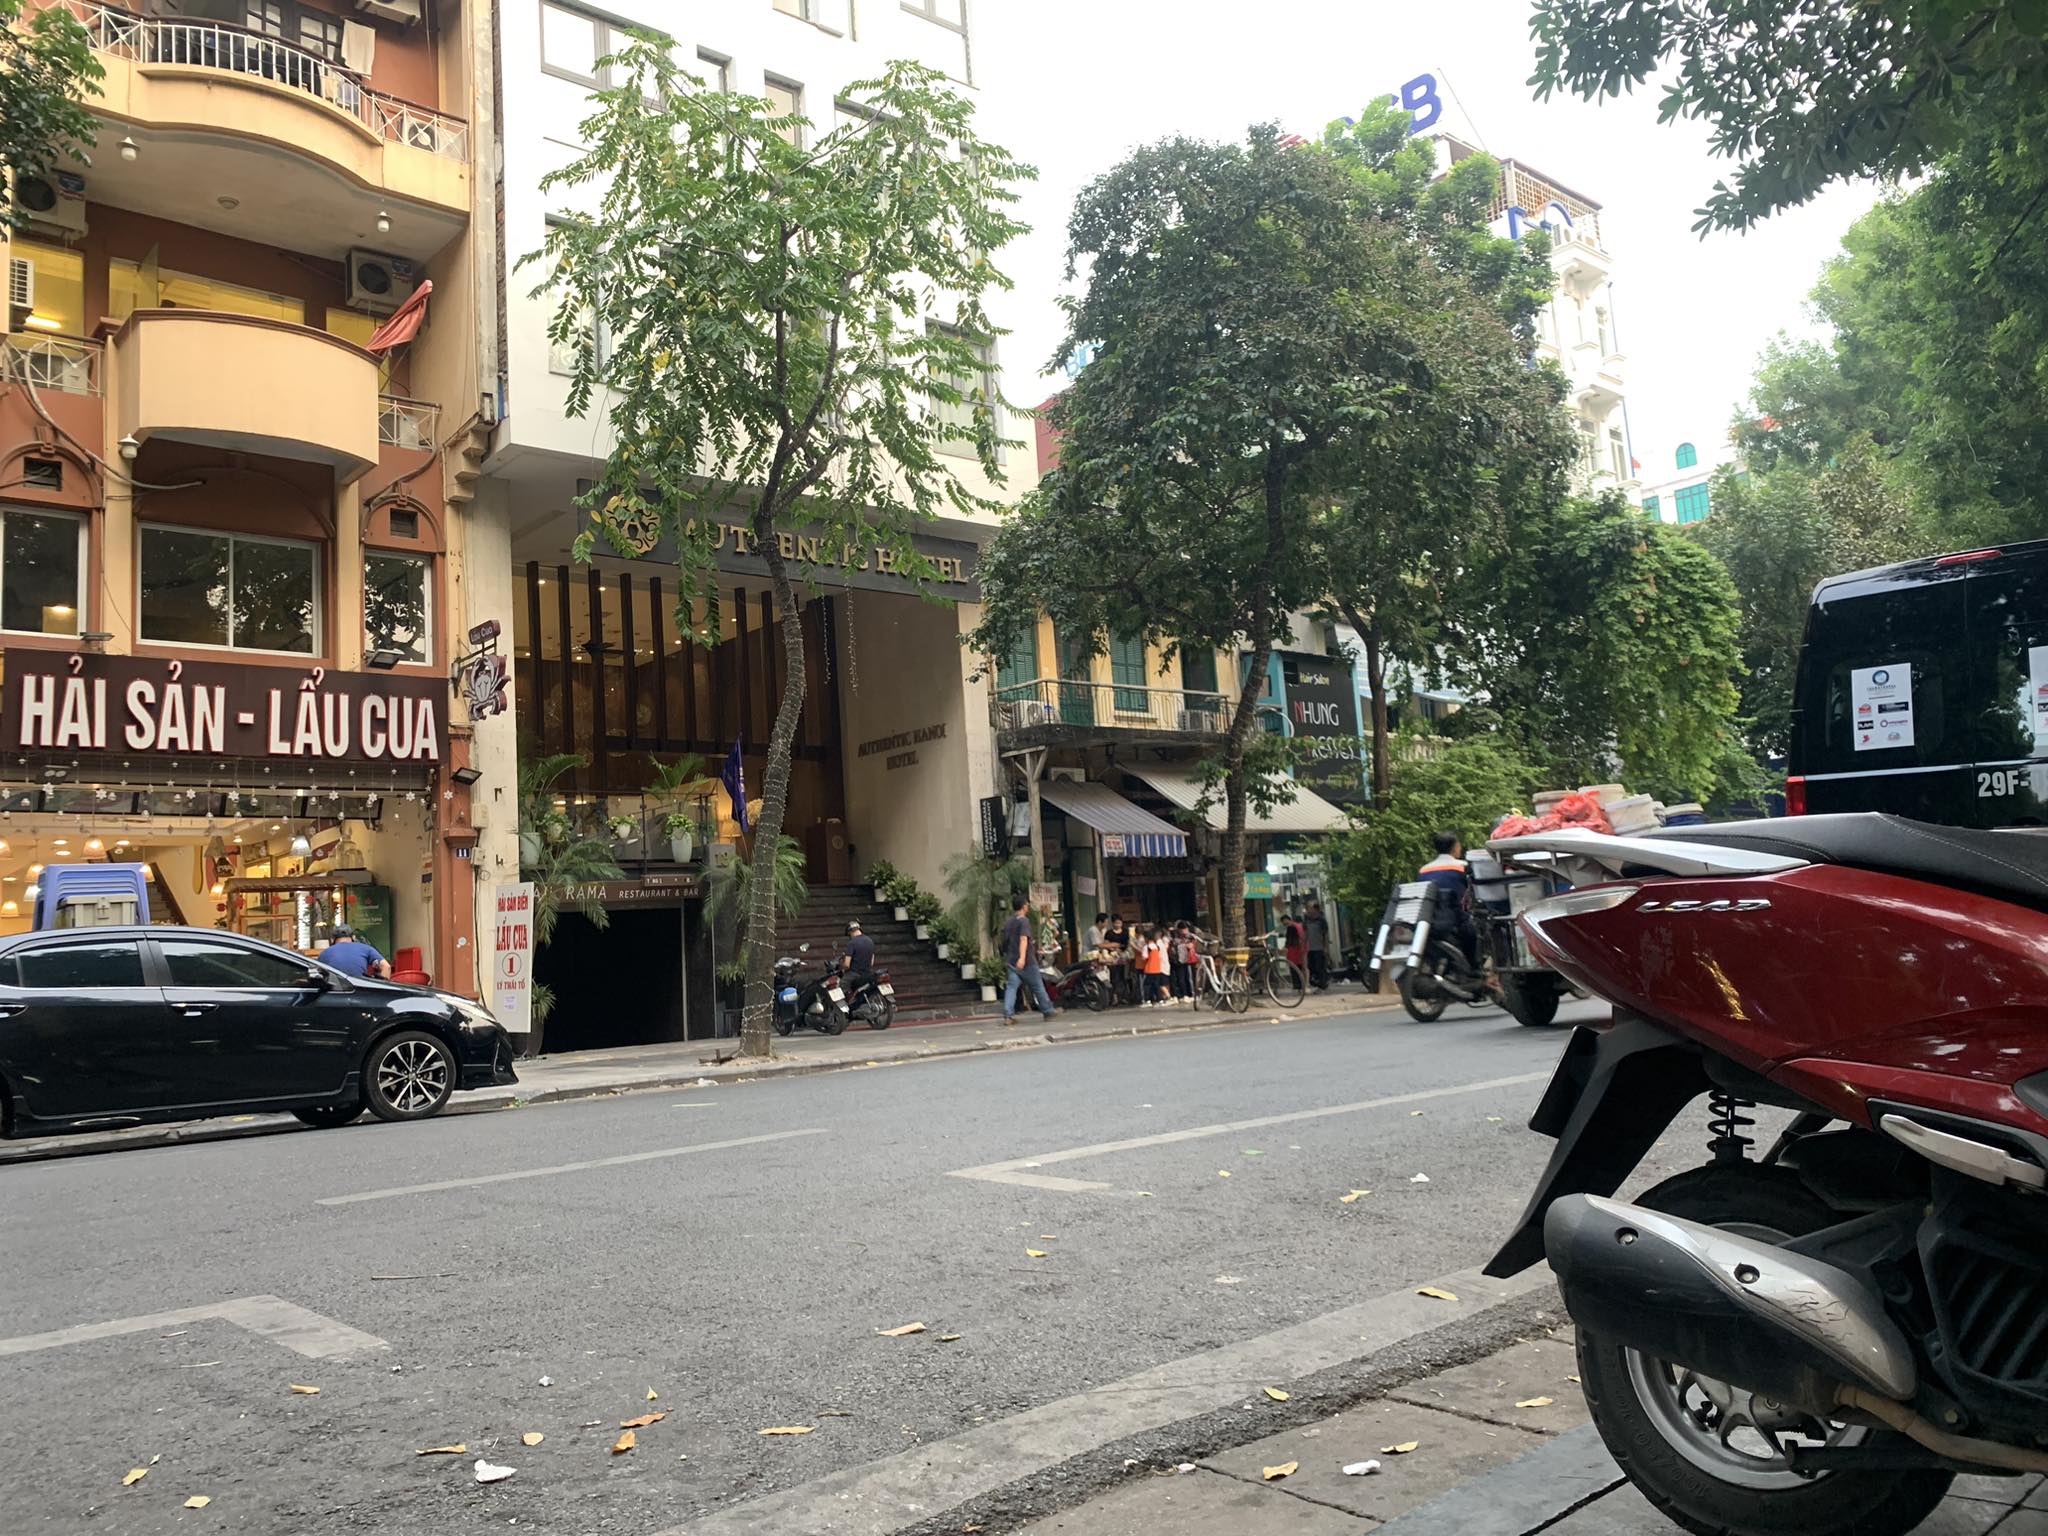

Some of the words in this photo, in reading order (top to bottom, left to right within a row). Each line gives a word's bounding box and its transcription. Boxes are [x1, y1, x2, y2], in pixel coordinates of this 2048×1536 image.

[875, 547, 969, 585] HTEL
[19, 655, 107, 748] HẢI
[125, 659, 226, 752] SẢN
[268, 666, 350, 758] LẨU
[361, 693, 439, 760] CUA
[1294, 701, 1340, 726] NHUNG
[619, 887, 671, 898] RESTAURANT
[1635, 899, 1771, 913] LEAD
[513, 924, 528, 950] CUA
[508, 956, 516, 974] 1
